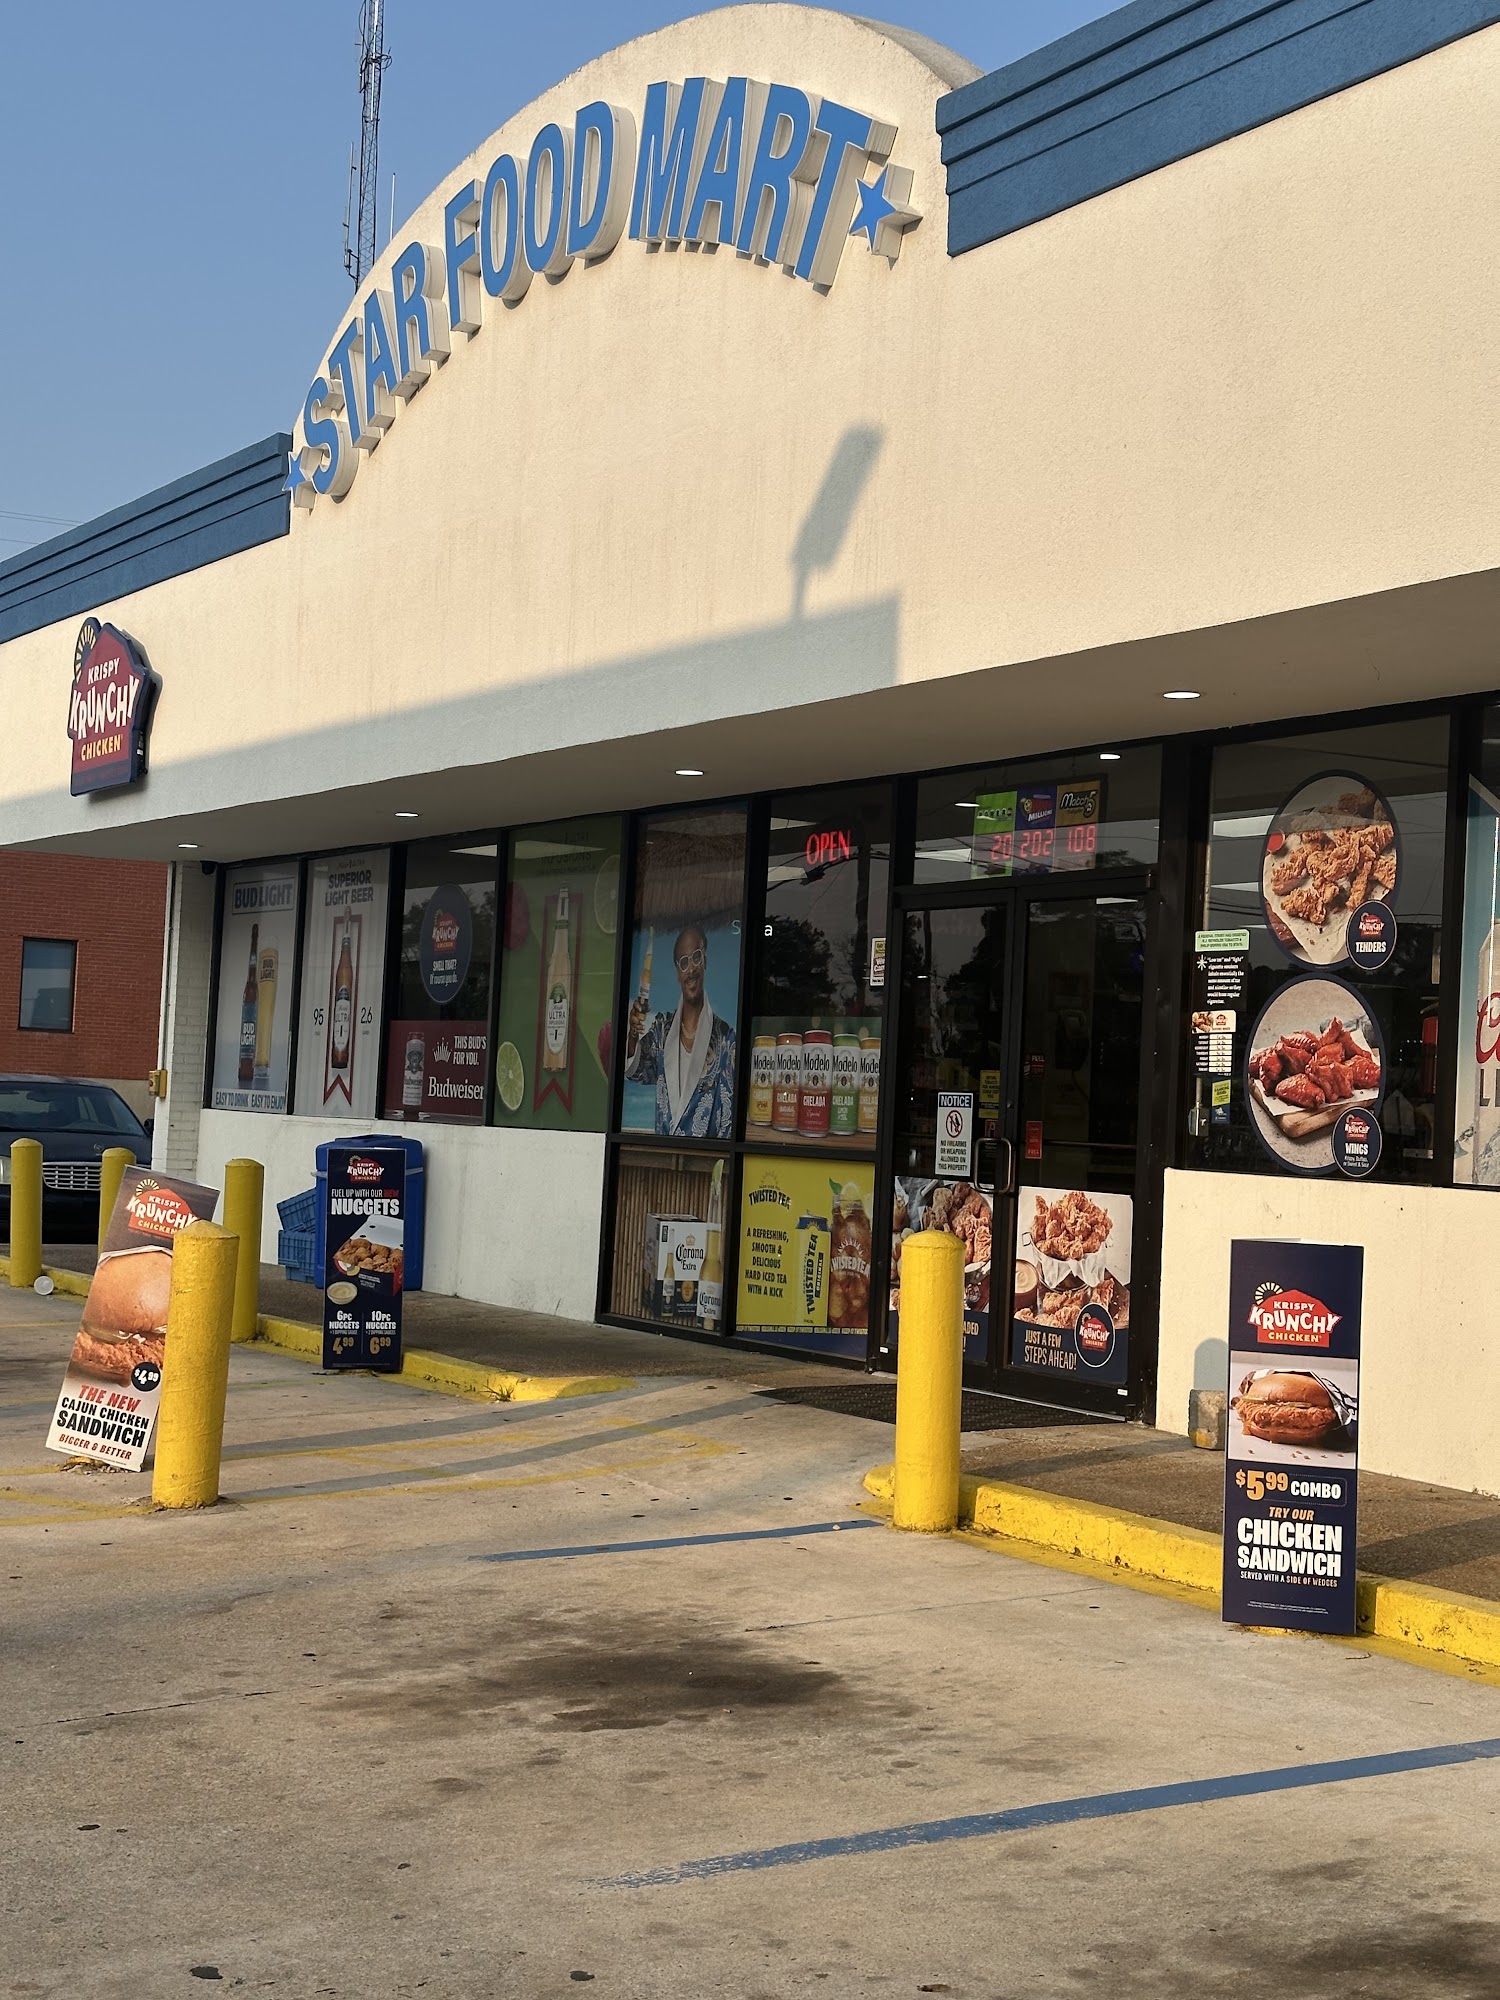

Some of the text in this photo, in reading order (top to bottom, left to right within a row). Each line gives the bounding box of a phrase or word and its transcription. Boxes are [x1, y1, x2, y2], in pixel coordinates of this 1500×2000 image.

[303, 77, 882, 496] STAR FOOD MART
[88, 657, 120, 685] KRISPY
[69, 674, 140, 740] KRUNCHY
[81, 734, 122, 761] CHICKEN
[1061, 793, 1088, 809] Match
[1028, 809, 1053, 821] MILLIONS
[806, 829, 851, 865] OPEN
[991, 834, 1012, 860] 20
[1020, 829, 1054, 859] 202
[329, 870, 371, 889] SUPERIOR
[235, 884, 293, 909] BUD LIGHT
[325, 887, 373, 907] LIGHT BEER
[1355, 942, 1387, 953] TENDERS
[314, 1008, 324, 1025] 95
[549, 1011, 566, 1020] ULTRA
[243, 1023, 254, 1034] BUD
[241, 1035, 255, 1046] LIGHT
[454, 1035, 487, 1049] THIS BUD'S
[453, 1052, 480, 1065] FOR YOU.
[754, 1055, 775, 1070] Modelo
[777, 1054, 800, 1071] Modelo
[803, 1053, 829, 1071] Modelo
[833, 1055, 858, 1072] Modelo
[428, 1076, 484, 1099] Budweiser
[216, 1092, 227, 1106] EASY
[228, 1092, 234, 1106] TO
[252, 1094, 263, 1108] EASY
[264, 1095, 270, 1108] TO
[803, 1096, 826, 1107] CHELADA
[832, 1095, 854, 1106] CHELADA
[940, 1095, 970, 1107] NOTICE
[1345, 1143, 1369, 1155] WINGS
[347, 1165, 384, 1176] KRUNCHY
[331, 1189, 345, 1197] FUEL
[345, 1189, 354, 1197] UP
[355, 1189, 369, 1197] WITH
[370, 1189, 383, 1197] OUR
[749, 1189, 791, 1210] TWISTED TEA
[149, 1195, 181, 1209] KRISPY
[331, 1198, 400, 1215] NUGGETS
[127, 1195, 198, 1229] KRUNCHY
[138, 1220, 178, 1235] CHICKEN
[747, 1228, 789, 1243] A REFRESHING,
[675, 1243, 704, 1262] Corona
[752, 1242, 782, 1255] SMOOTH &
[807, 1234, 818, 1256] TEA
[681, 1260, 696, 1270] Extra
[752, 1256, 781, 1269] DELICIOUS
[745, 1269, 787, 1284] HARD ICED TEA
[747, 1284, 783, 1298] WITH A KICK
[806, 1258, 815, 1314] TWISTED
[699, 1292, 720, 1307] Corona
[1273, 1301, 1315, 1311] KRISPY
[337, 1310, 352, 1321] 6PC
[371, 1310, 391, 1321] 10PC
[703, 1305, 716, 1315] Extra
[329, 1321, 360, 1329] NUGGETS
[365, 1321, 396, 1330] NUGGETS
[963, 1320, 979, 1335] ADED
[1249, 1306, 1340, 1334] KRUNCHY
[1024, 1330, 1062, 1348] JUST A FEW
[1079, 1326, 1110, 1342] KRUNCHY
[1268, 1332, 1319, 1342] CHICKEN
[1024, 1345, 1077, 1370] STEPS AHEAD!
[78, 1384, 141, 1413] THE NEW
[61, 1397, 149, 1430] CAJUN CHICKEN
[57, 1410, 146, 1448] SANDWICH
[59, 1433, 90, 1449] BIGGER
[91, 1442, 98, 1451] &
[100, 1445, 132, 1460] BETTER
[1290, 1480, 1342, 1500] COMBO
[1269, 1506, 1315, 1521] TRY OUR
[1237, 1517, 1343, 1552] CHICKEN
[1237, 1545, 1342, 1577] SANDWICH
[1240, 1570, 1338, 1588] SERVED WITH A SIDE OF WEDGES
